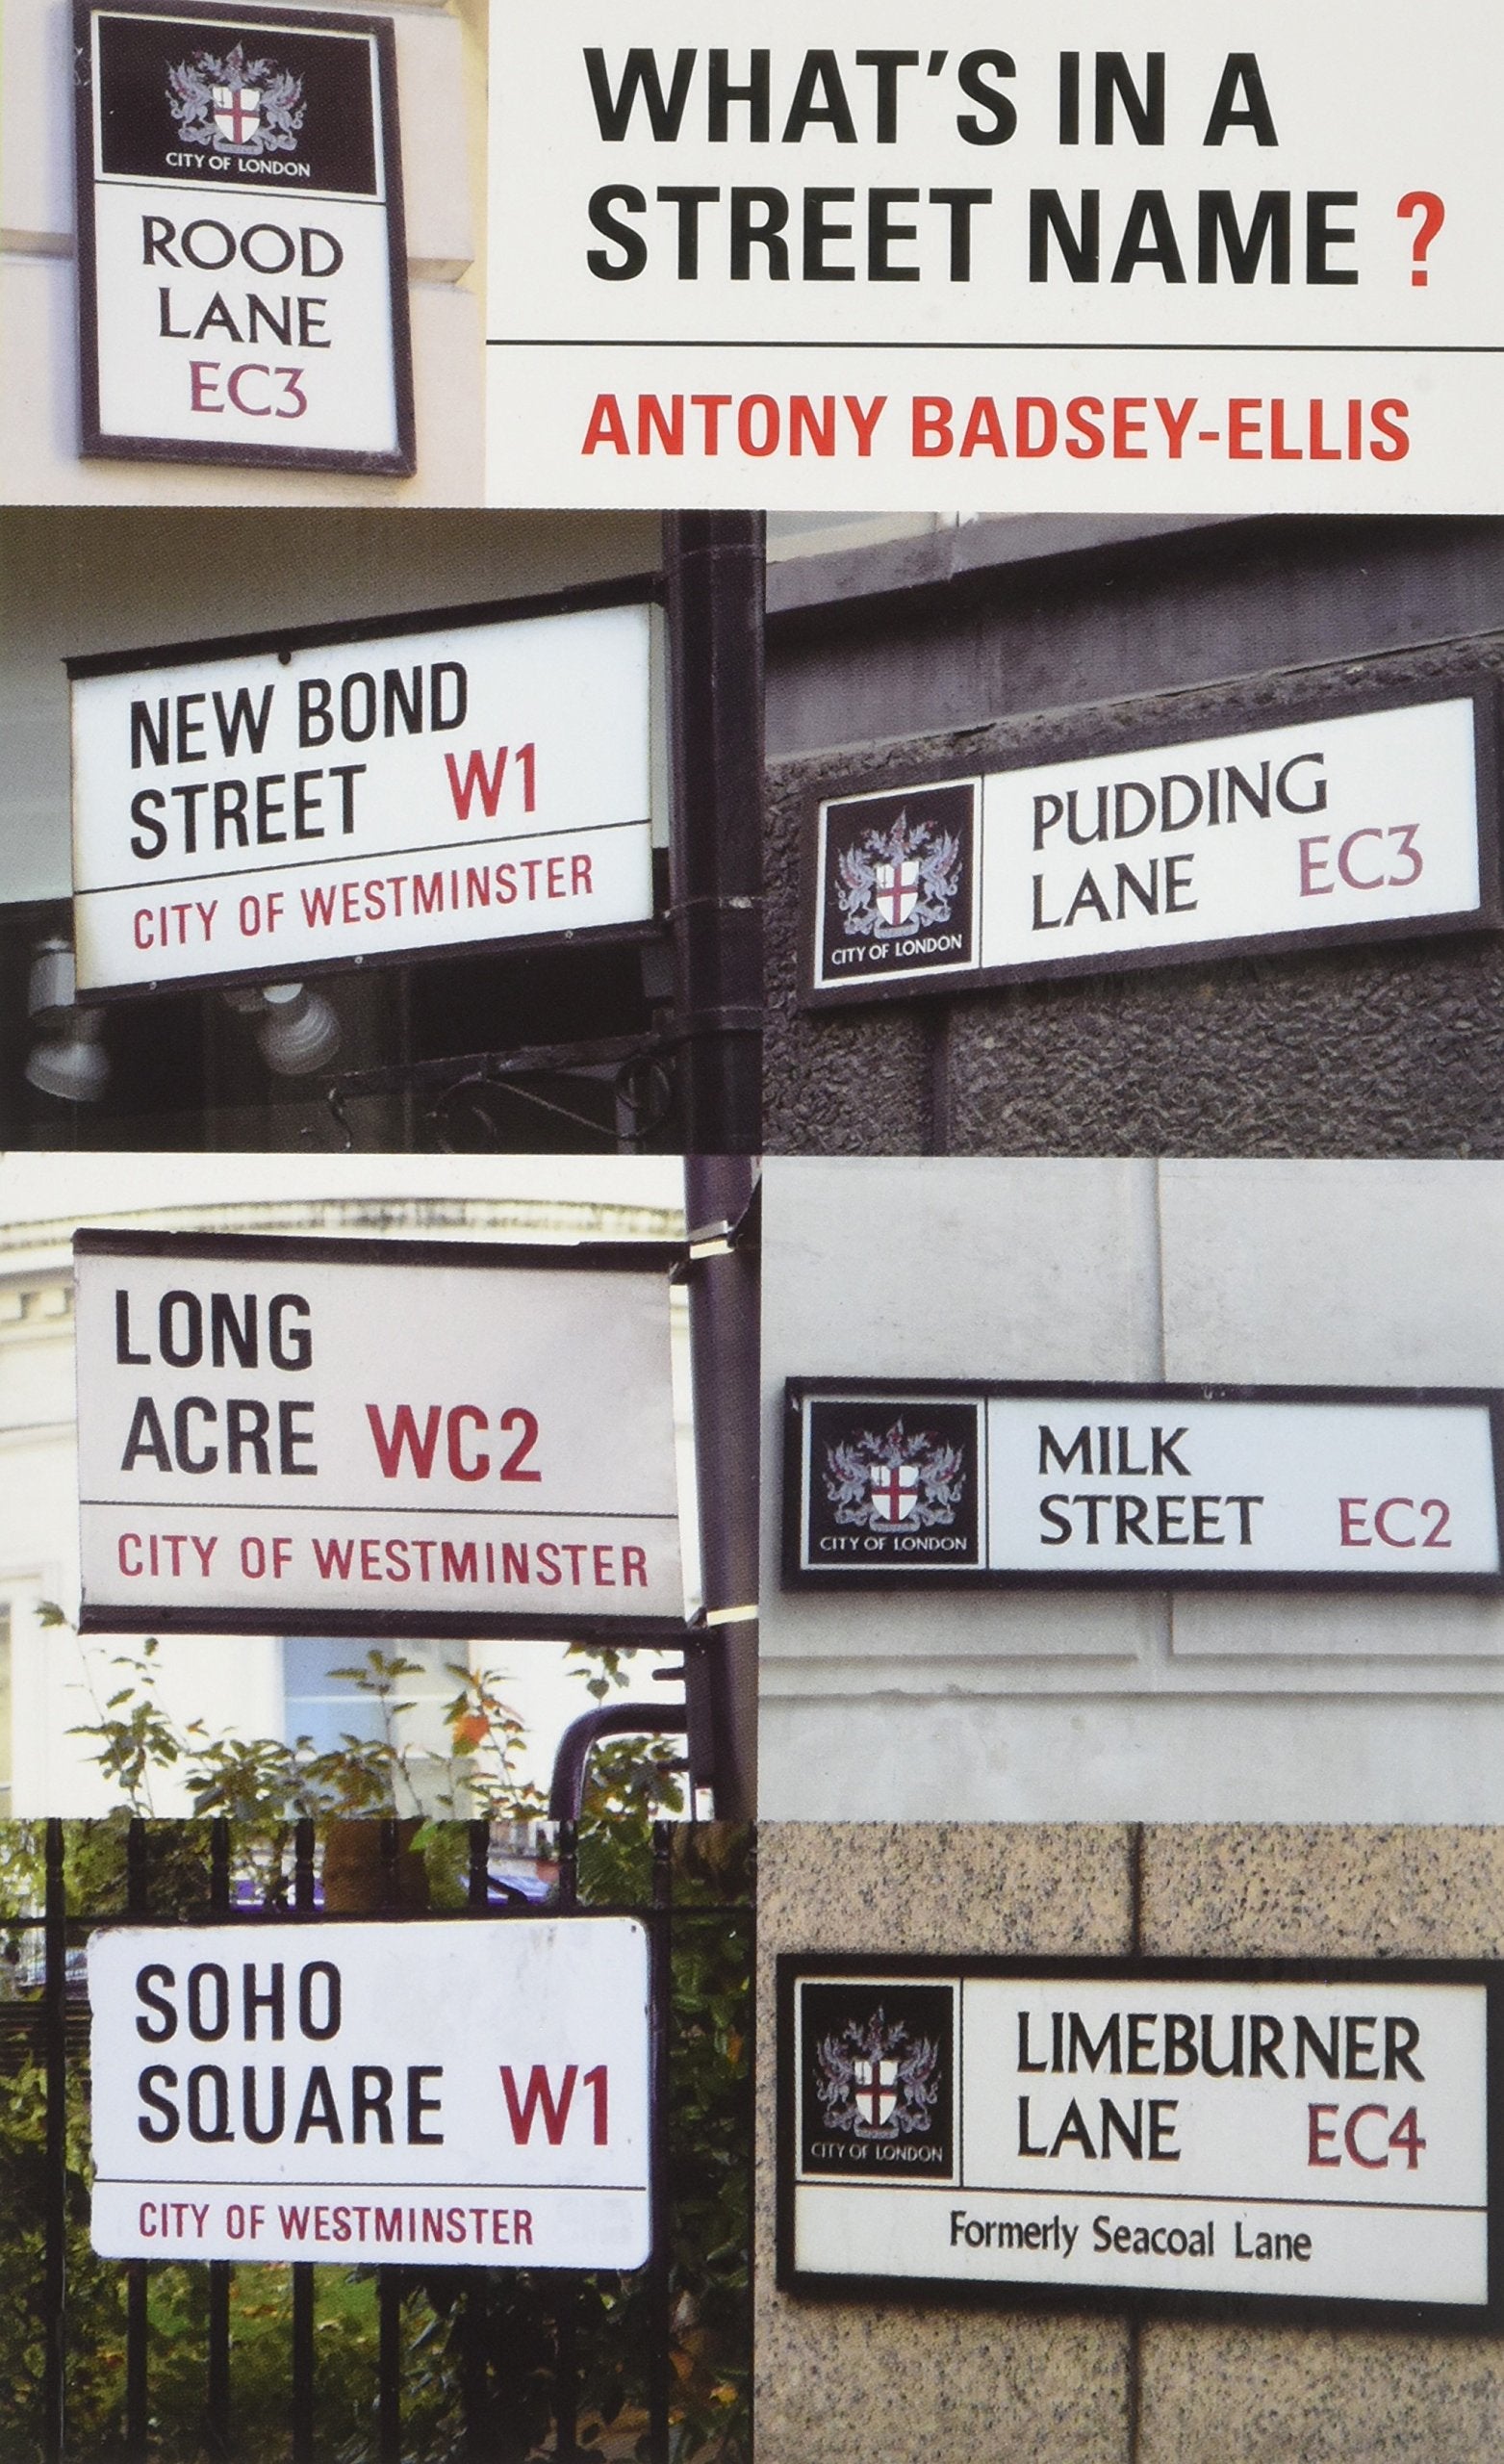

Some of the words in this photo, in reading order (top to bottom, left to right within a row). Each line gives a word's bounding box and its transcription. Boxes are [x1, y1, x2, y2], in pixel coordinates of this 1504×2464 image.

[582, 47, 1018, 146] WHAT'S
[1058, 51, 1165, 146] IN
[1202, 52, 1279, 147] A
[165, 152, 206, 169] CITY
[208, 155, 232, 171] OF
[238, 158, 311, 178] LONDON
[141, 215, 344, 278] ROOD
[586, 184, 993, 283] STREET
[1029, 189, 1359, 286] NAME
[158, 287, 332, 348] LANE
[189, 360, 308, 419] EC3
[580, 394, 888, 457] ANTONY
[911, 396, 1410, 462] BADSEY-ELLIS
[130, 683, 275, 769] NEW
[298, 660, 468, 749] BOND
[130, 763, 368, 860] STREET
[444, 742, 536, 821] W1
[1032, 752, 1329, 852] PUDDING
[134, 899, 218, 950] CITY
[239, 891, 284, 937] OF
[300, 854, 595, 928] WESTMINSTER
[1032, 853, 1198, 931] LANE
[1298, 823, 1423, 897] EC3
[830, 946, 867, 965] CITY
[868, 943, 890, 961] OF
[895, 934, 963, 958] LONDON
[115, 1289, 313, 1372] LONG
[120, 1396, 319, 1476] ACRE
[365, 1403, 542, 1482] WC2
[1037, 1424, 1191, 1476] MILK
[819, 1536, 860, 1552] CITY
[863, 1536, 886, 1552] OF
[893, 1536, 967, 1552] LONDON
[1039, 1493, 1264, 1546] STREET
[1338, 1497, 1452, 1549] EC2
[117, 1532, 218, 1578] CITY
[240, 1536, 293, 1579] OF
[312, 1538, 649, 1587] WESTMINSTER
[135, 1960, 342, 2044] SOHO
[1017, 2011, 1425, 2083] LIMEBURNER
[138, 2064, 445, 2145] SQUARE
[499, 2064, 608, 2145] W1
[1017, 2095, 1182, 2162] LANE
[1307, 2102, 1427, 2170] EC4
[810, 2142, 846, 2159] CITY
[849, 2143, 869, 2160] OF
[876, 2143, 943, 2163] LONDON
[139, 2201, 210, 2238] CITY
[226, 2204, 266, 2240] OF
[278, 2205, 533, 2246] WESTMINSTER
[950, 2209, 1080, 2259] Formerly
[1092, 2215, 1214, 2258] Seacoal
[1235, 2220, 1313, 2263] Lane
